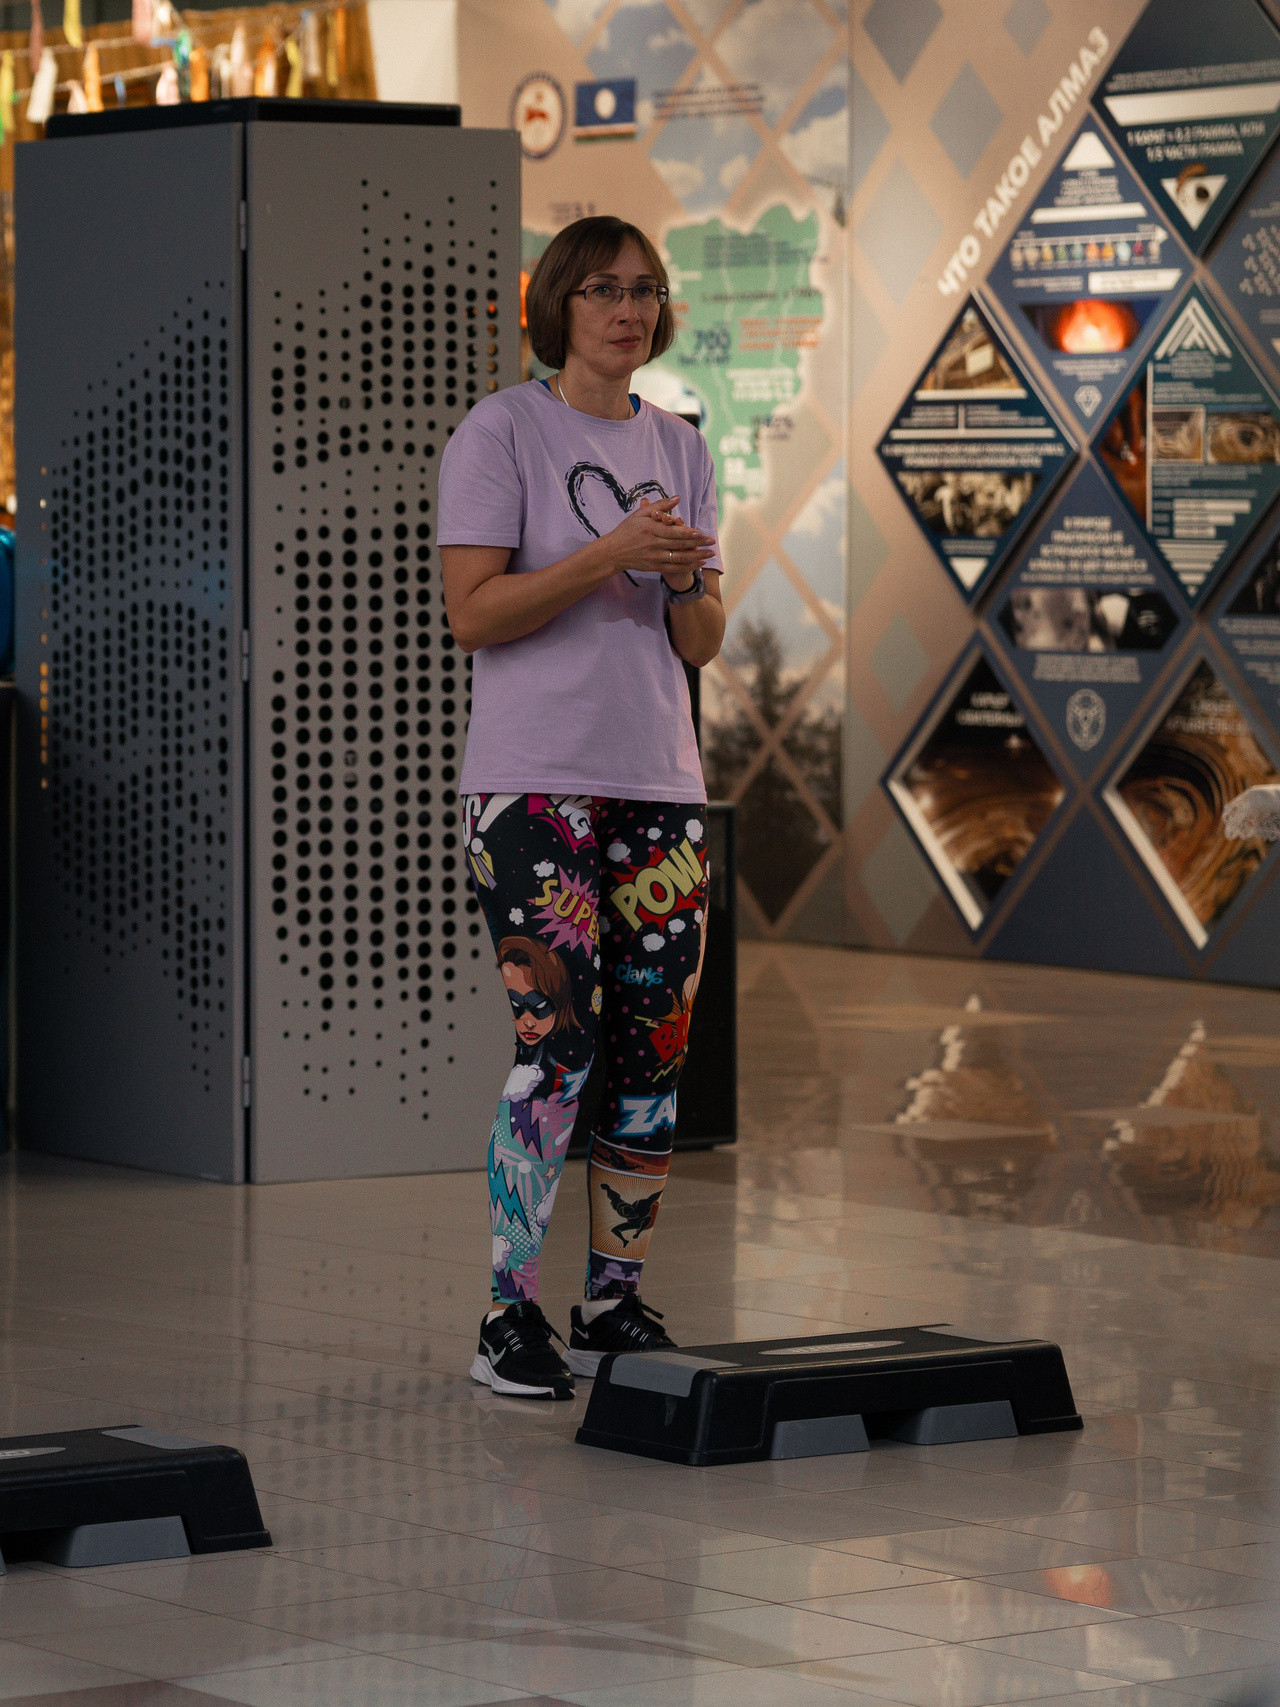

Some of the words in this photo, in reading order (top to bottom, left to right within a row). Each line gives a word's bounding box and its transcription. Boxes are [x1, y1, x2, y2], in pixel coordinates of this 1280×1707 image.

[936, 234, 982, 297] ЧТО
[973, 135, 1043, 239] ТАКОЕ
[1036, 25, 1110, 148] АЛМАЗ
[610, 838, 704, 931] POW
[617, 1088, 677, 1135] ZA
